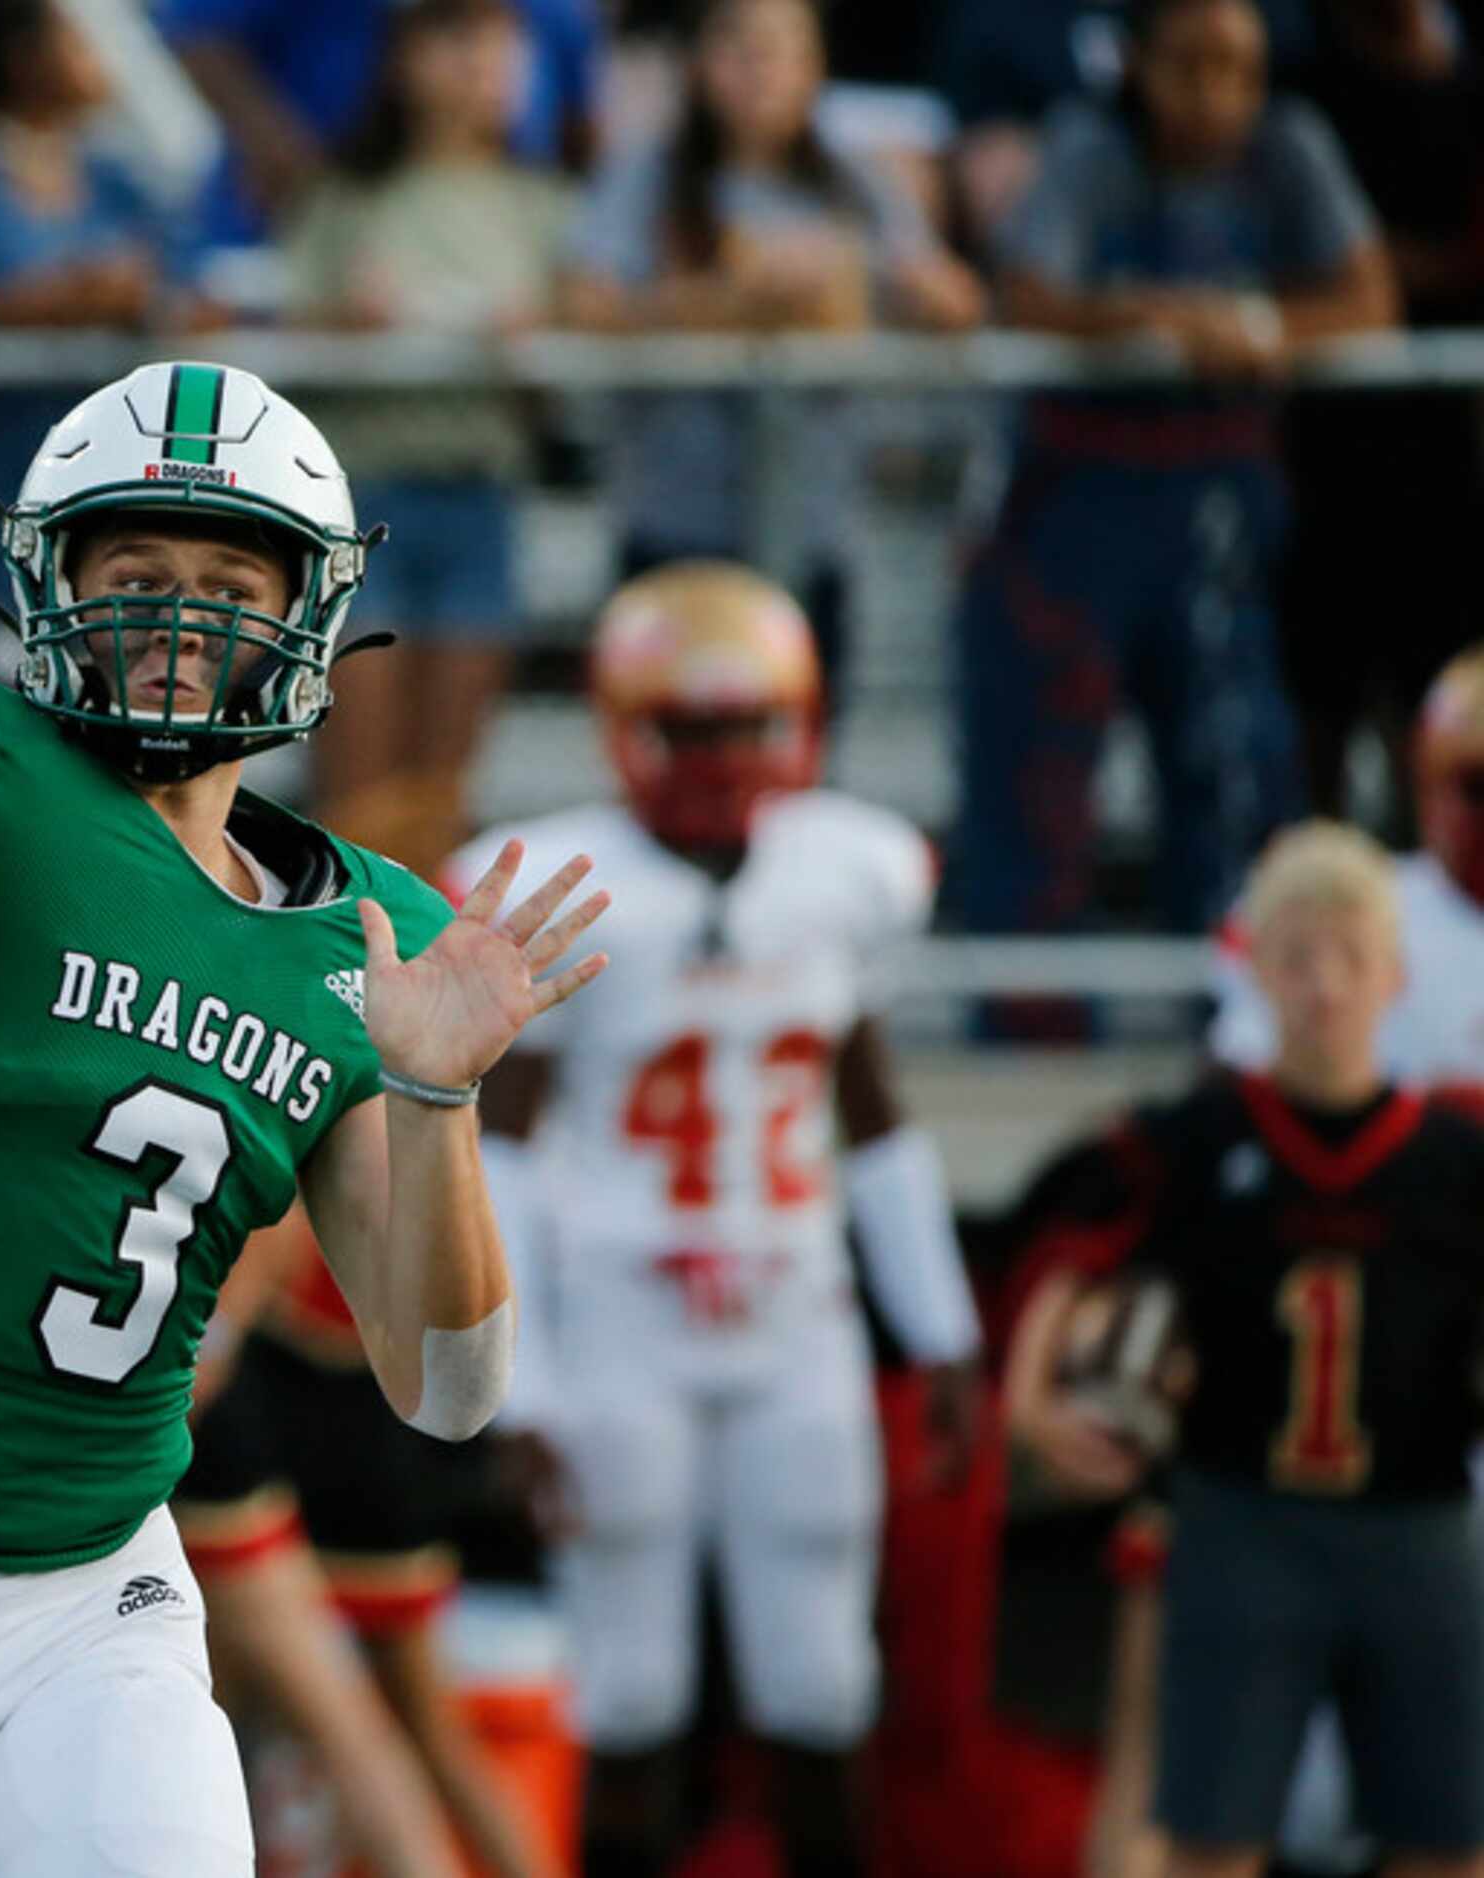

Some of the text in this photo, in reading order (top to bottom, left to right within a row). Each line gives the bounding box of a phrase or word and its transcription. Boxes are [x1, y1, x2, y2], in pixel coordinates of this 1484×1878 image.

[162, 463, 226, 484] DRAGONS
[49, 949, 334, 1123] DRAGONS
[622, 1028, 834, 1212] 42
[35, 1078, 232, 1387] 3
[1271, 1258, 1370, 1492] 1
